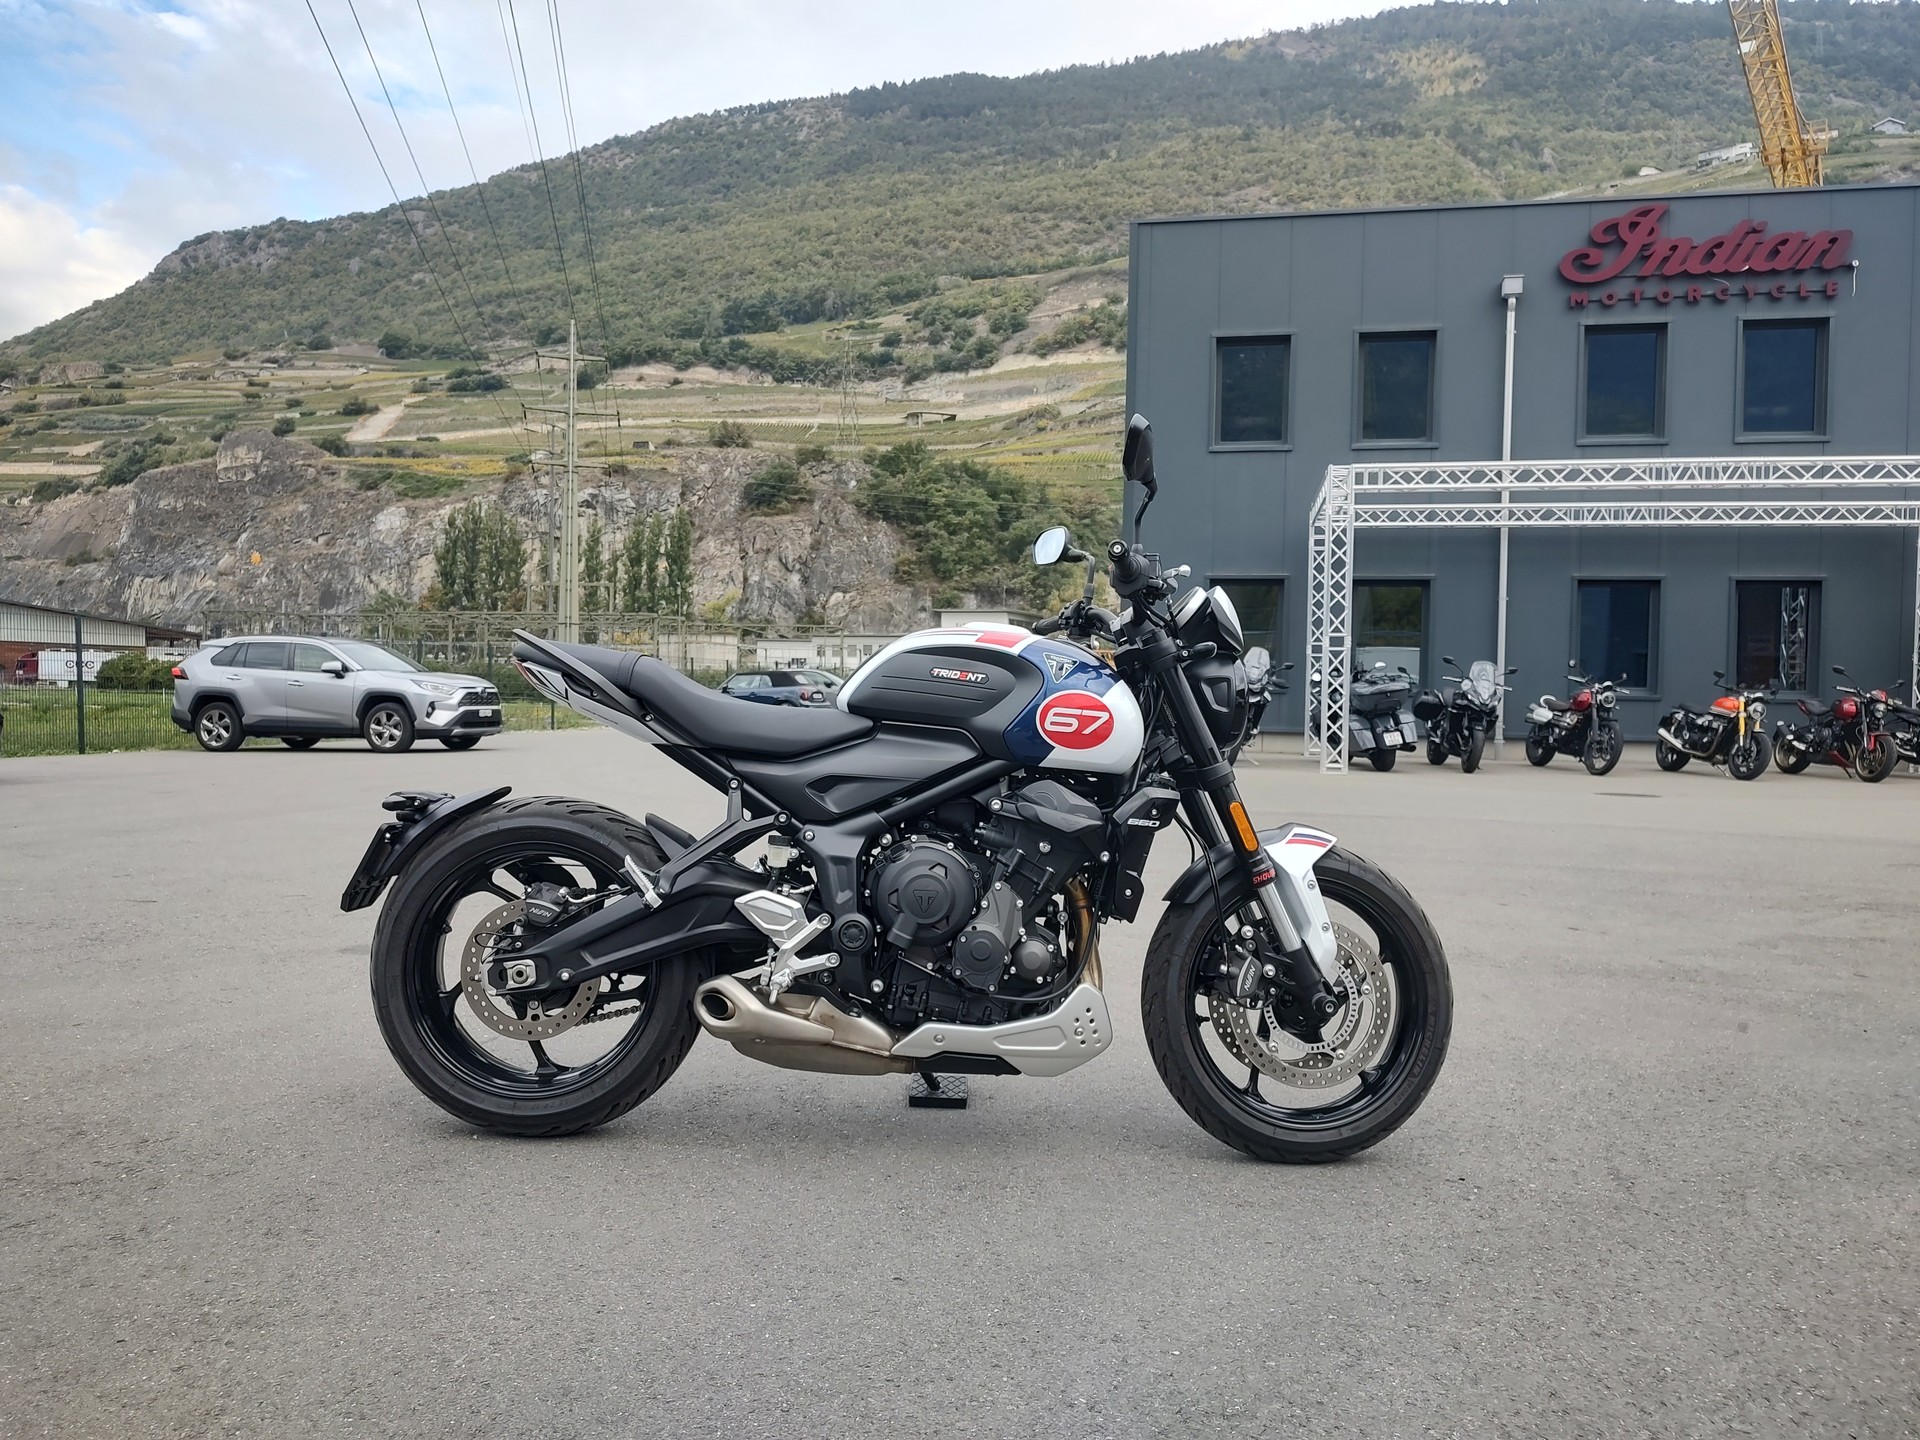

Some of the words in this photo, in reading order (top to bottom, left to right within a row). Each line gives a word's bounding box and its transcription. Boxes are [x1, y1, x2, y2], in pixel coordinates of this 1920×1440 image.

[1559, 204, 1854, 284] Indian
[1569, 280, 1839, 308] MOTORCYCLE
[930, 668, 987, 682] TRIDENT
[1044, 706, 1110, 735] 67
[1127, 818, 1160, 828] 660
[1412, 1014, 1436, 1077] MICHELIN
